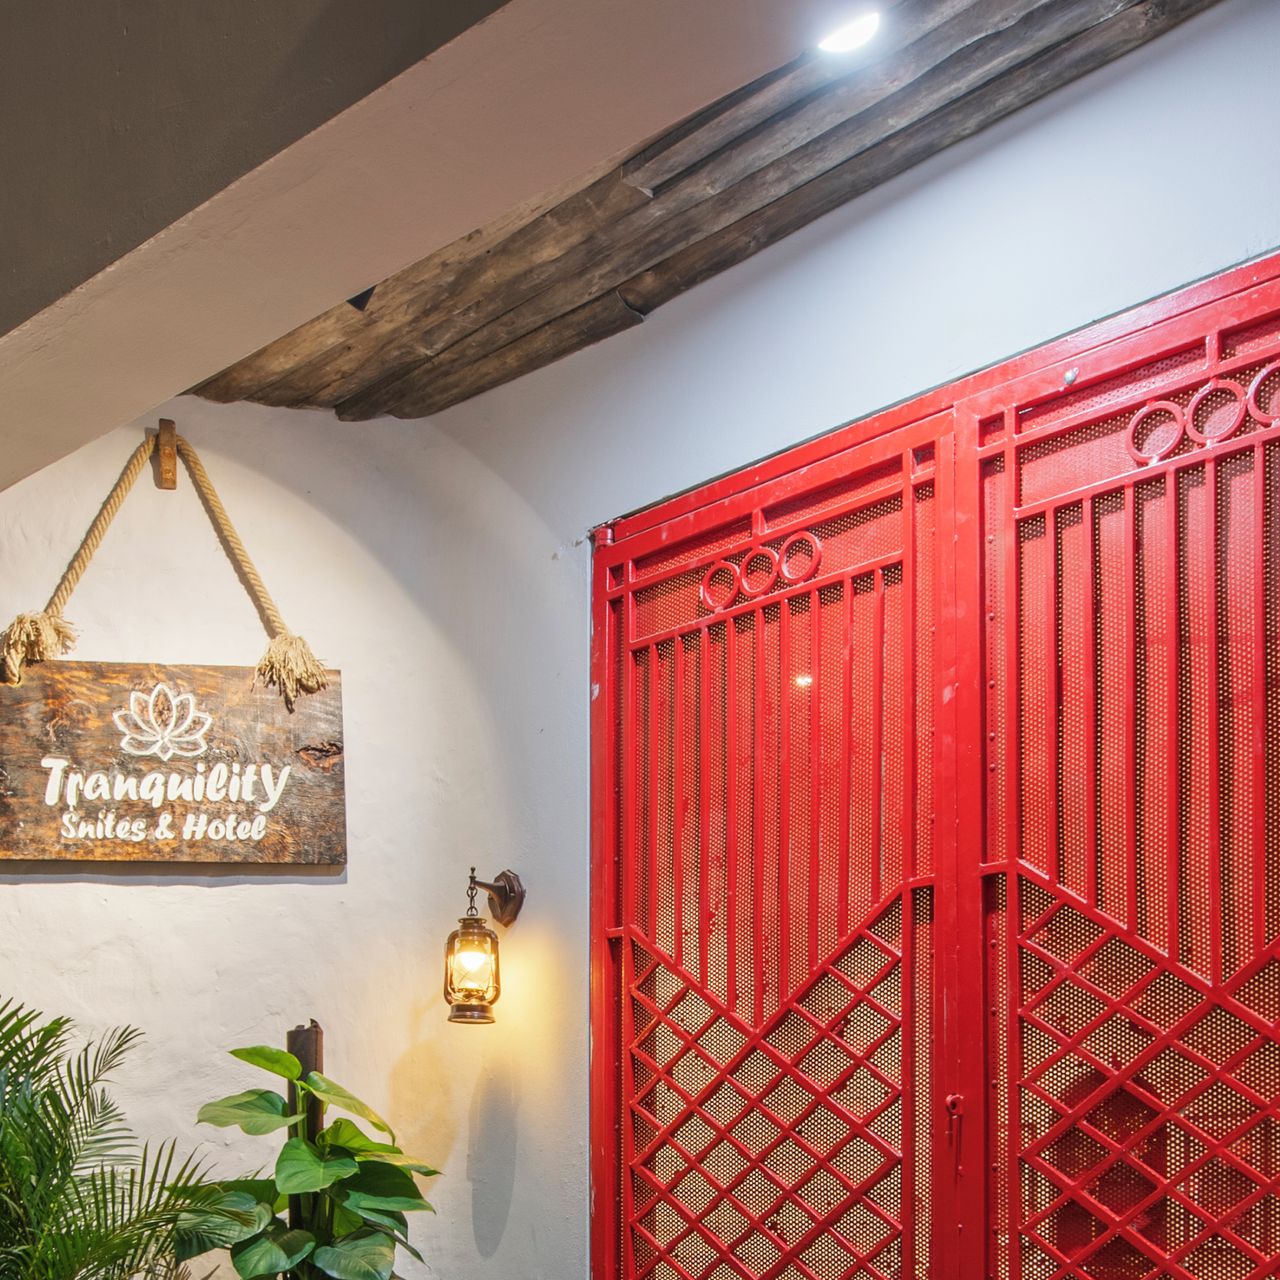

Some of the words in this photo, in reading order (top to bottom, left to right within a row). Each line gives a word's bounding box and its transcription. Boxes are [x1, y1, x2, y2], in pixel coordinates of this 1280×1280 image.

[40, 757, 291, 813] Tranquility
[61, 811, 148, 842] Suites
[156, 812, 176, 841] &
[182, 812, 267, 841] Hotel
